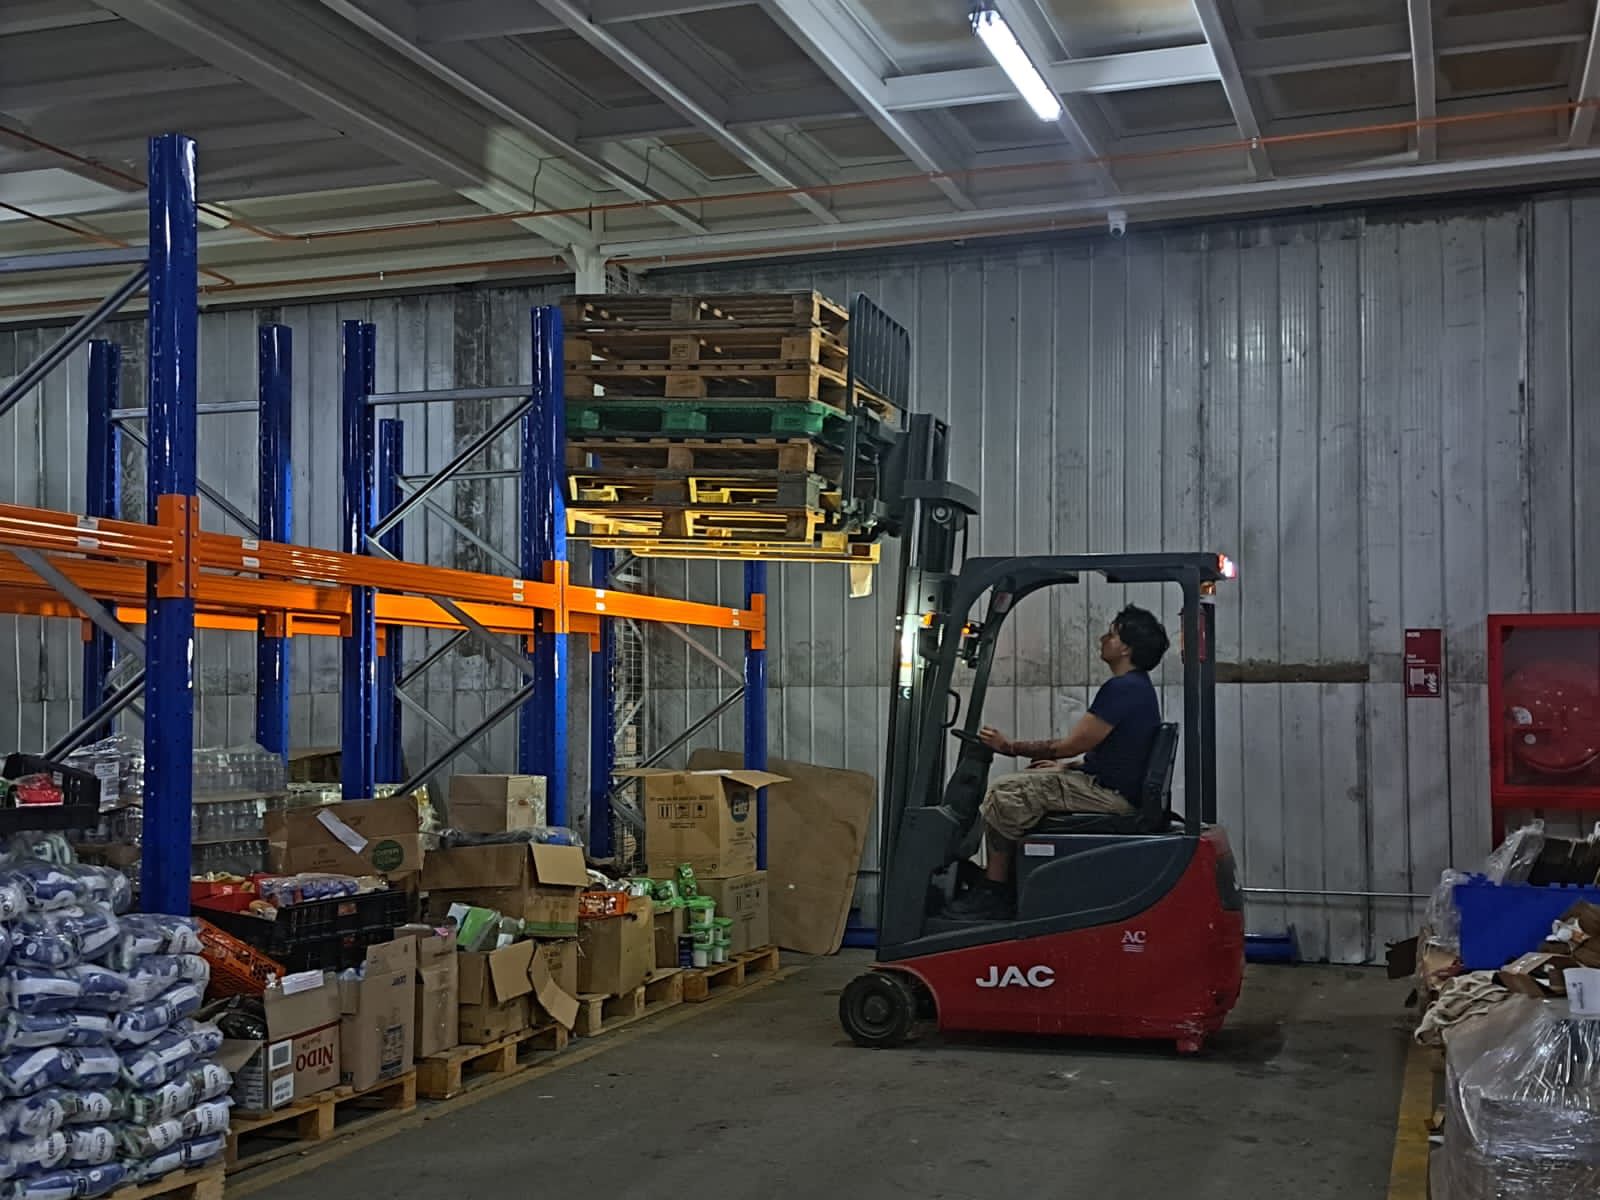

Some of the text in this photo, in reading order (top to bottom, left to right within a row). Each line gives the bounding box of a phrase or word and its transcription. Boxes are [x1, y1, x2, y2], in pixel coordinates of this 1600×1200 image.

[1121, 930, 1147, 944] AC
[975, 965, 1055, 988] JAC
[296, 1043, 334, 1072] NIDO
